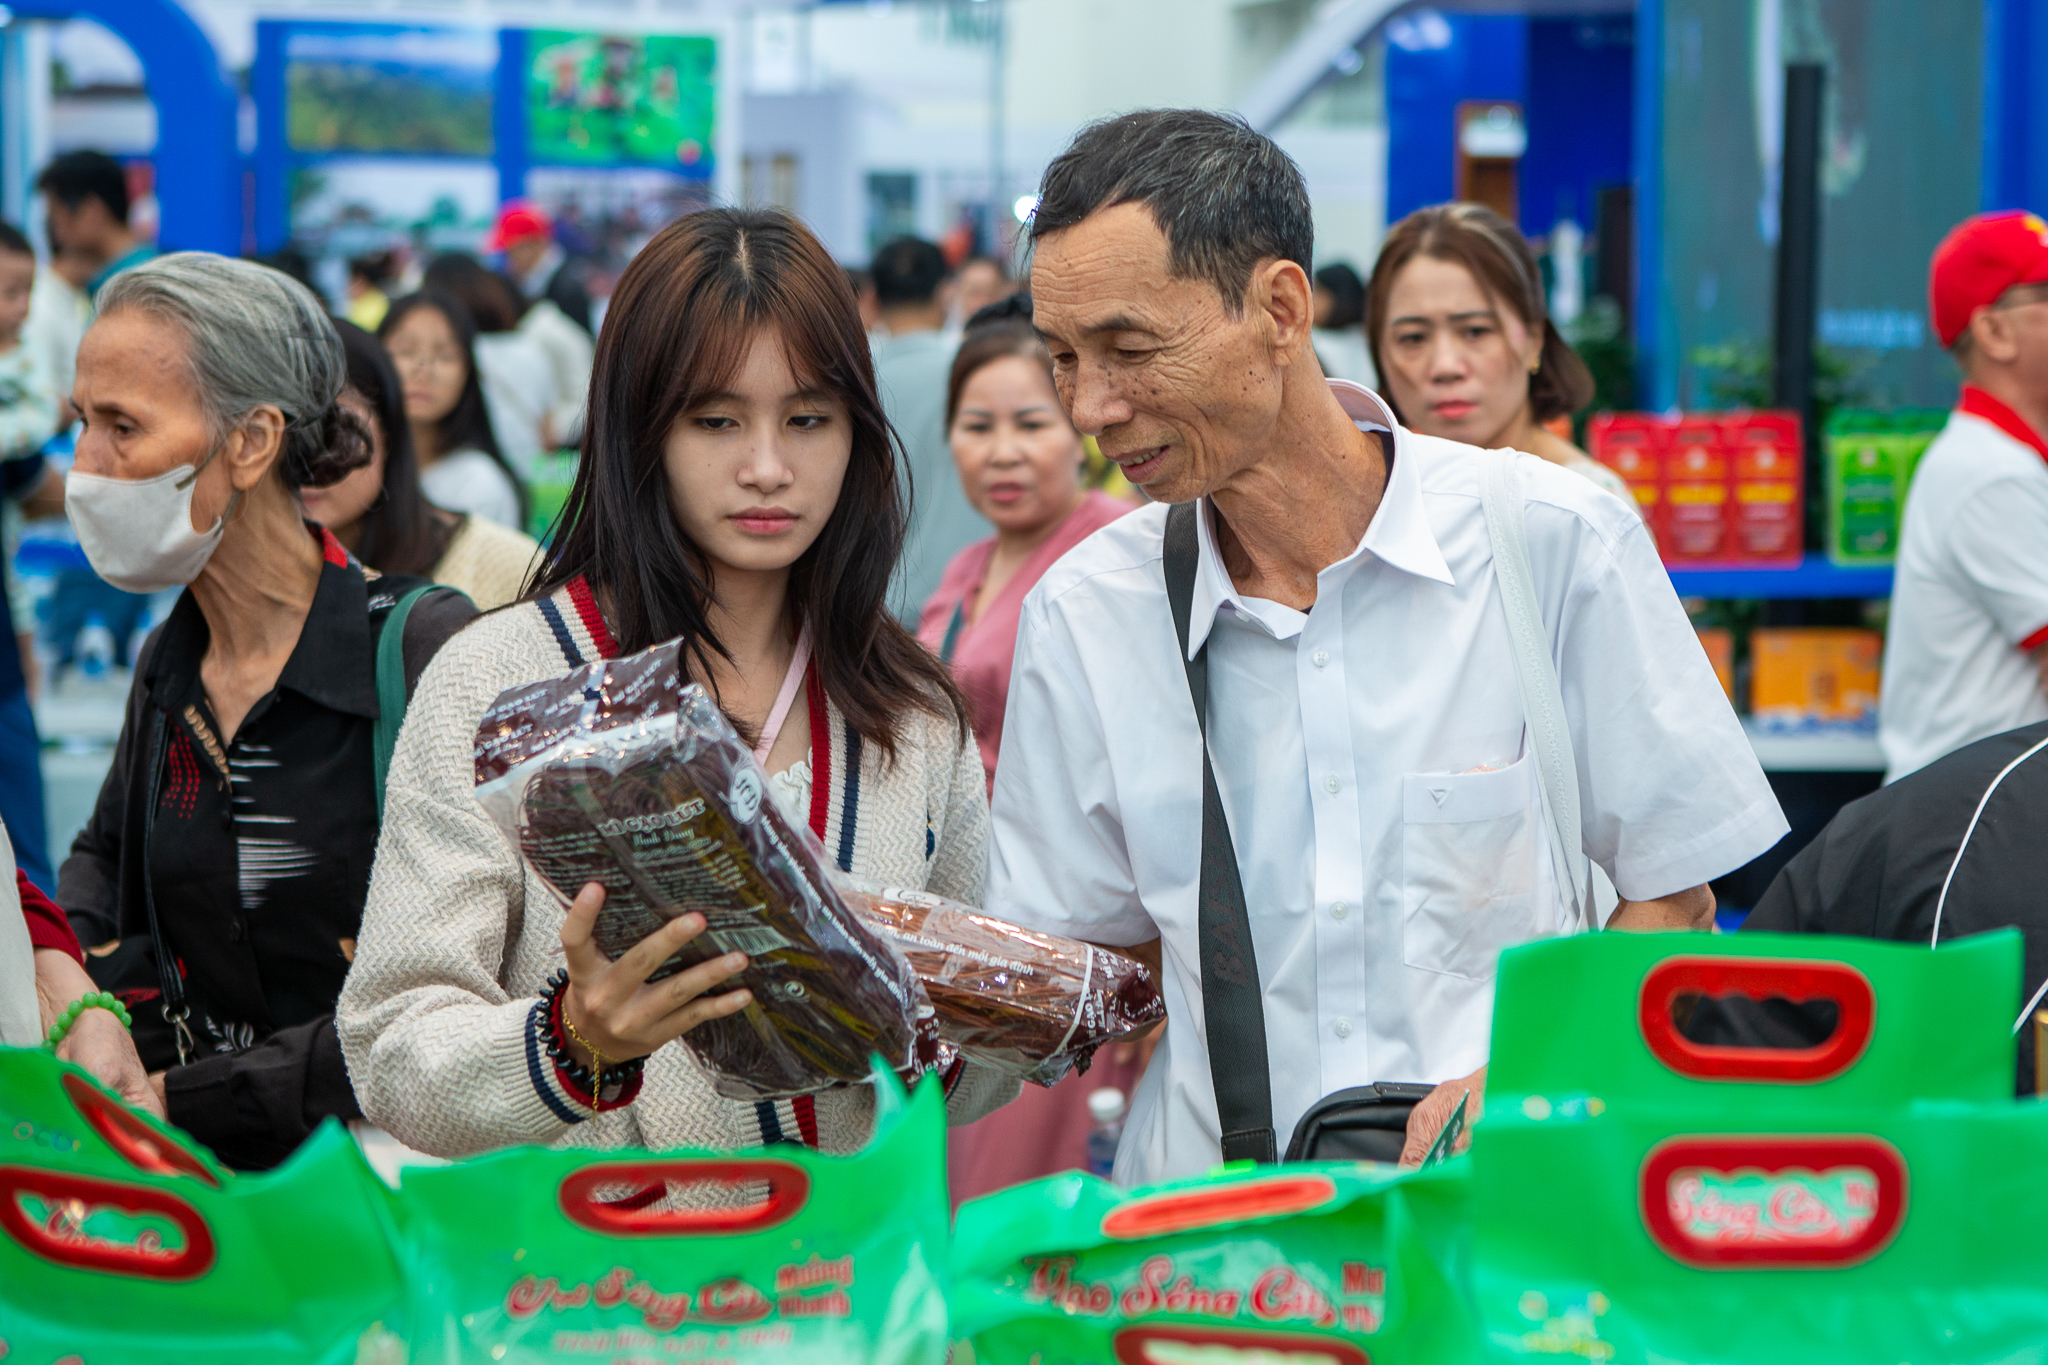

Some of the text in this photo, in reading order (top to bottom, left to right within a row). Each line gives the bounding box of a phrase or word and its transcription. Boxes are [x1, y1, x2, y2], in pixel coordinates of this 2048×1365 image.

[902, 933, 920, 944] an
[919, 934, 945, 951] toàn
[945, 942, 967, 957] đến
[989, 955, 1008, 970] gia
[1008, 959, 1035, 977] đình
